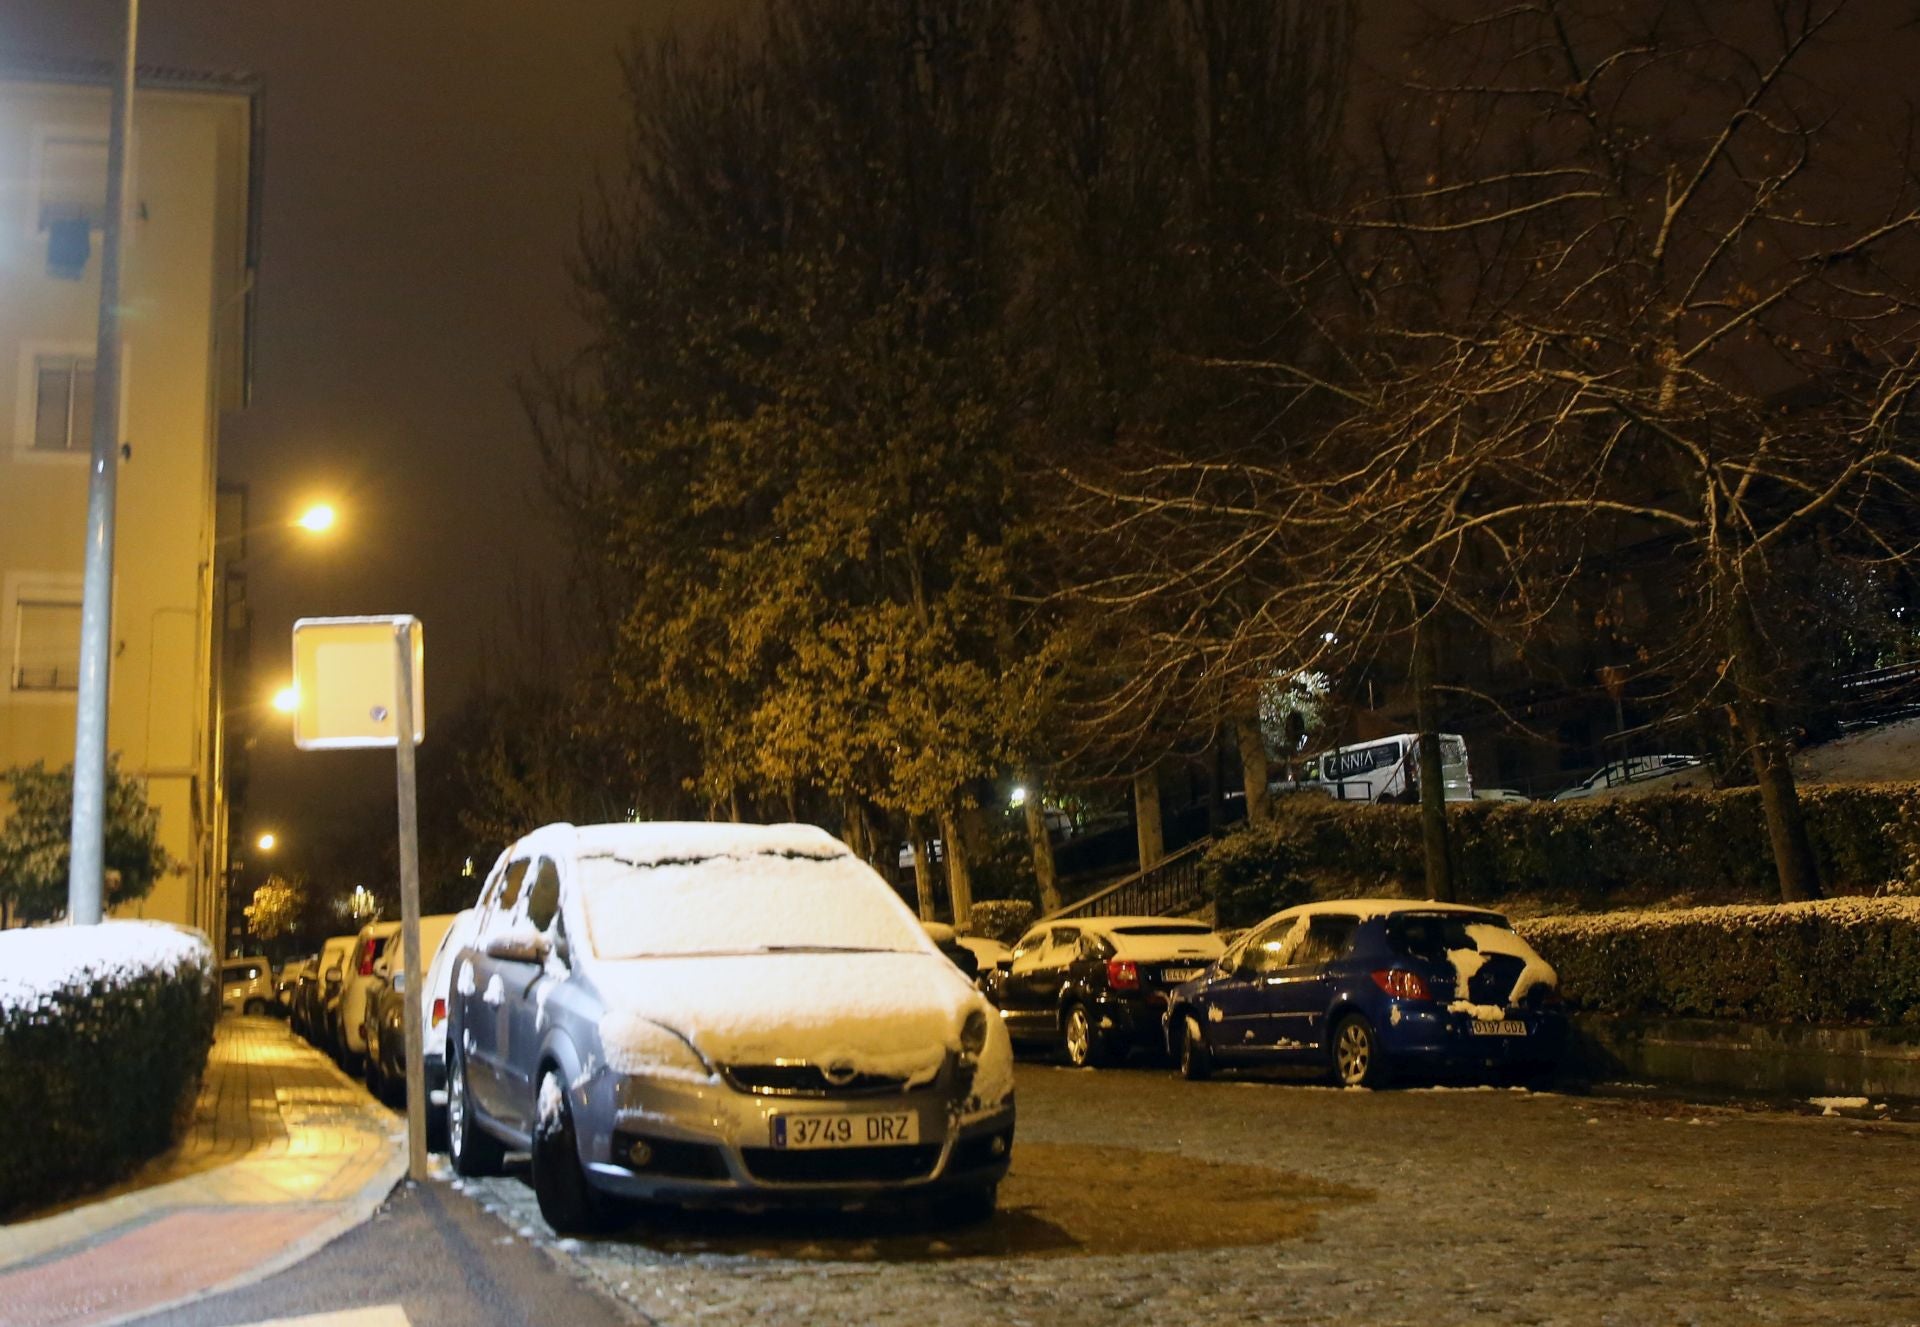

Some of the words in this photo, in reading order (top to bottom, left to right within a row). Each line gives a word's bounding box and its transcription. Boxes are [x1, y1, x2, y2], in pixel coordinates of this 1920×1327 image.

[1329, 750, 1374, 775] ZNNIA
[793, 1118, 852, 1144] 3749
[866, 1115, 909, 1141] DRZ
